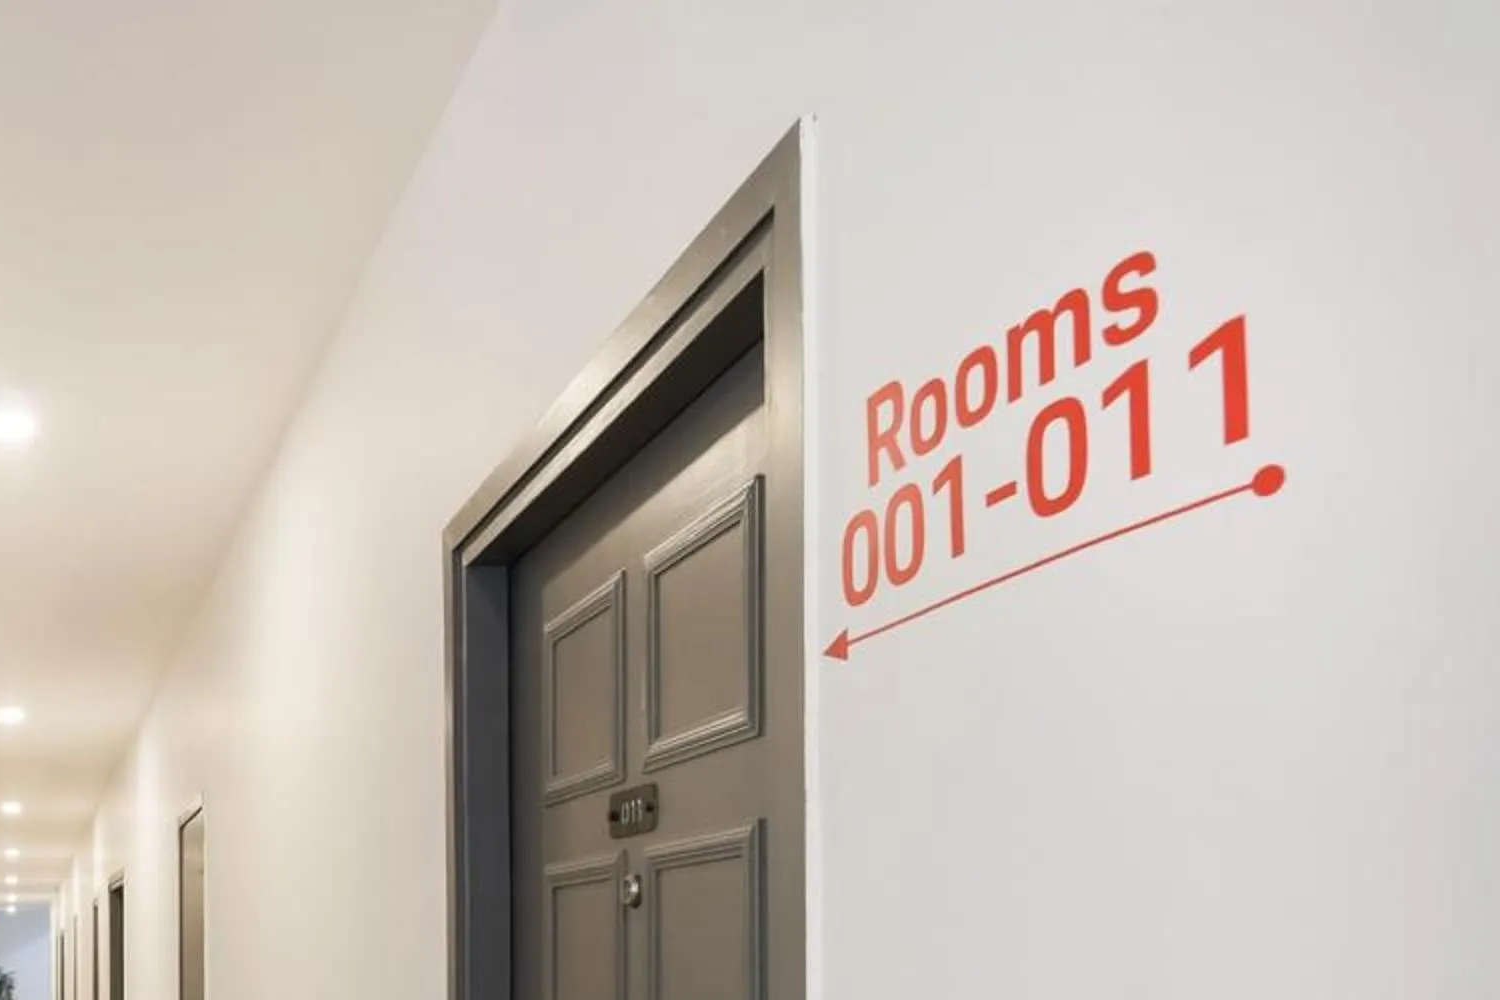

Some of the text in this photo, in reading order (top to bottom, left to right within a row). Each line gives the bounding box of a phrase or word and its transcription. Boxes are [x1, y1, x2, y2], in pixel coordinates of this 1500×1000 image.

[841, 313, 1250, 608] 001-011
[866, 250, 1160, 488] Rooms
[621, 797, 643, 825] 011
